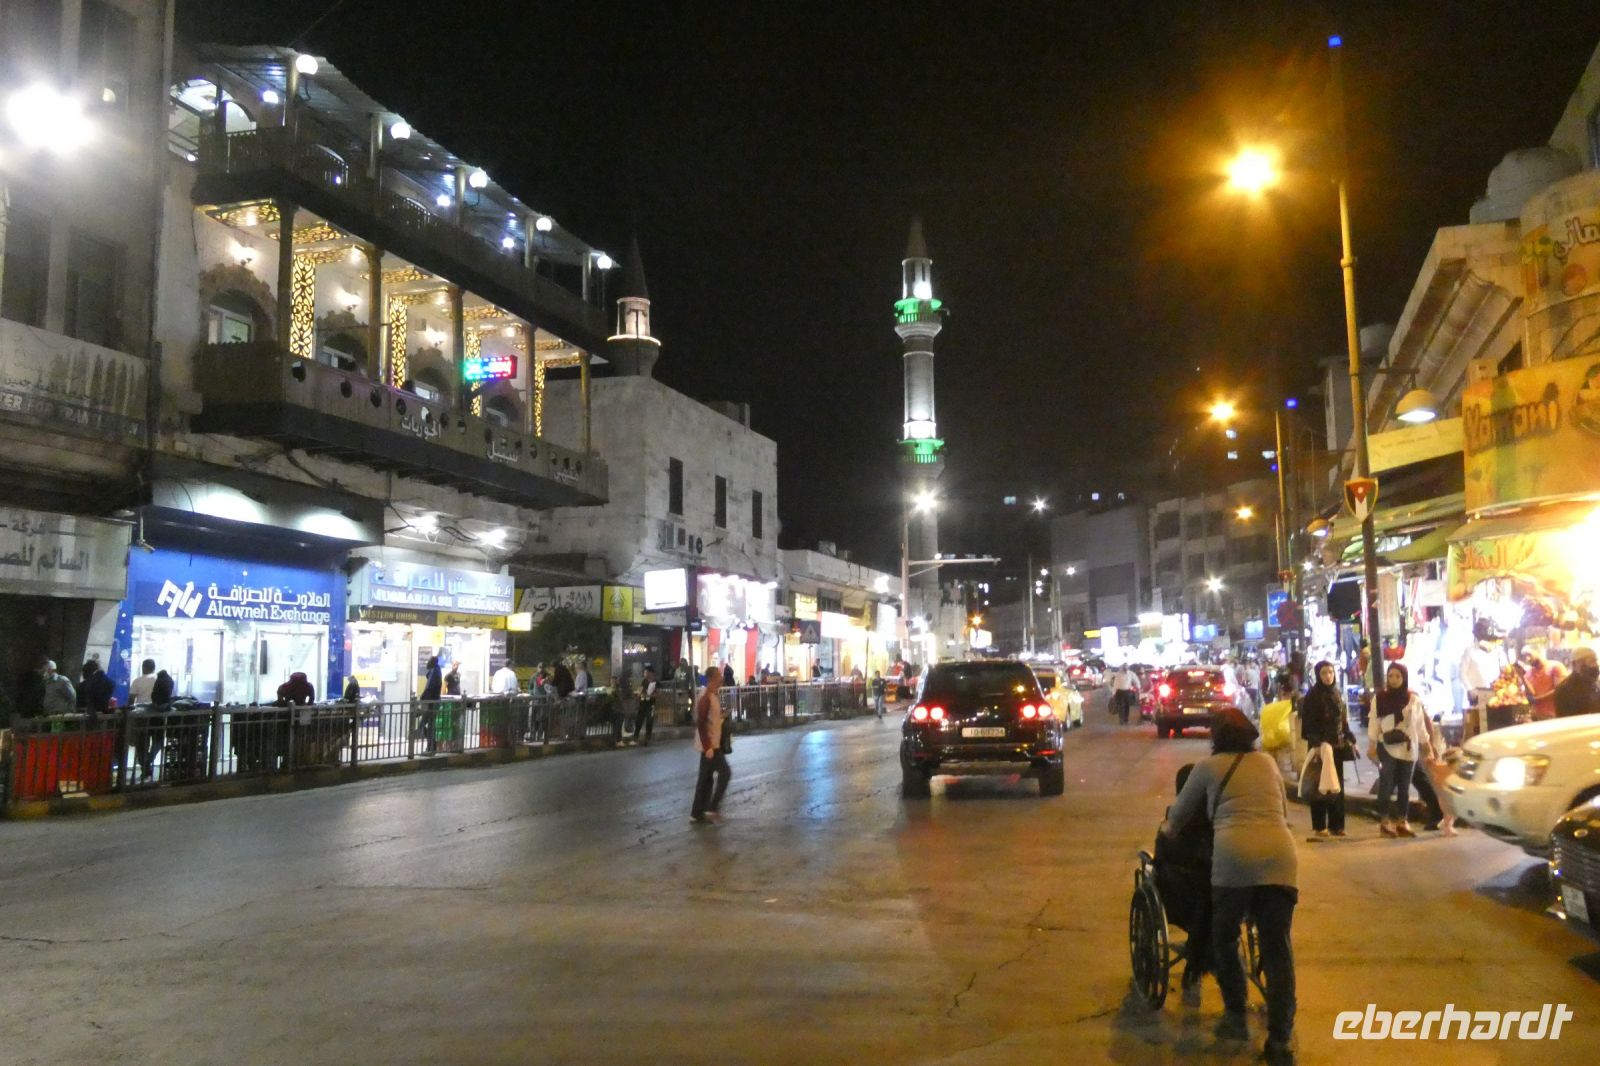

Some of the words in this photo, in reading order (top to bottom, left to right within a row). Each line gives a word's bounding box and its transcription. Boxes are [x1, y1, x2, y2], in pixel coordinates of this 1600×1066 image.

[401, 415, 442, 440] الحوريات
[208, 583, 272, 605] للصرافة
[457, 598, 511, 612] EXCHANGE
[207, 601, 269, 620] Alawneh
[270, 605, 331, 625] Exchange
[359, 608, 394, 620] WESTERN
[395, 611, 417, 621] UNION
